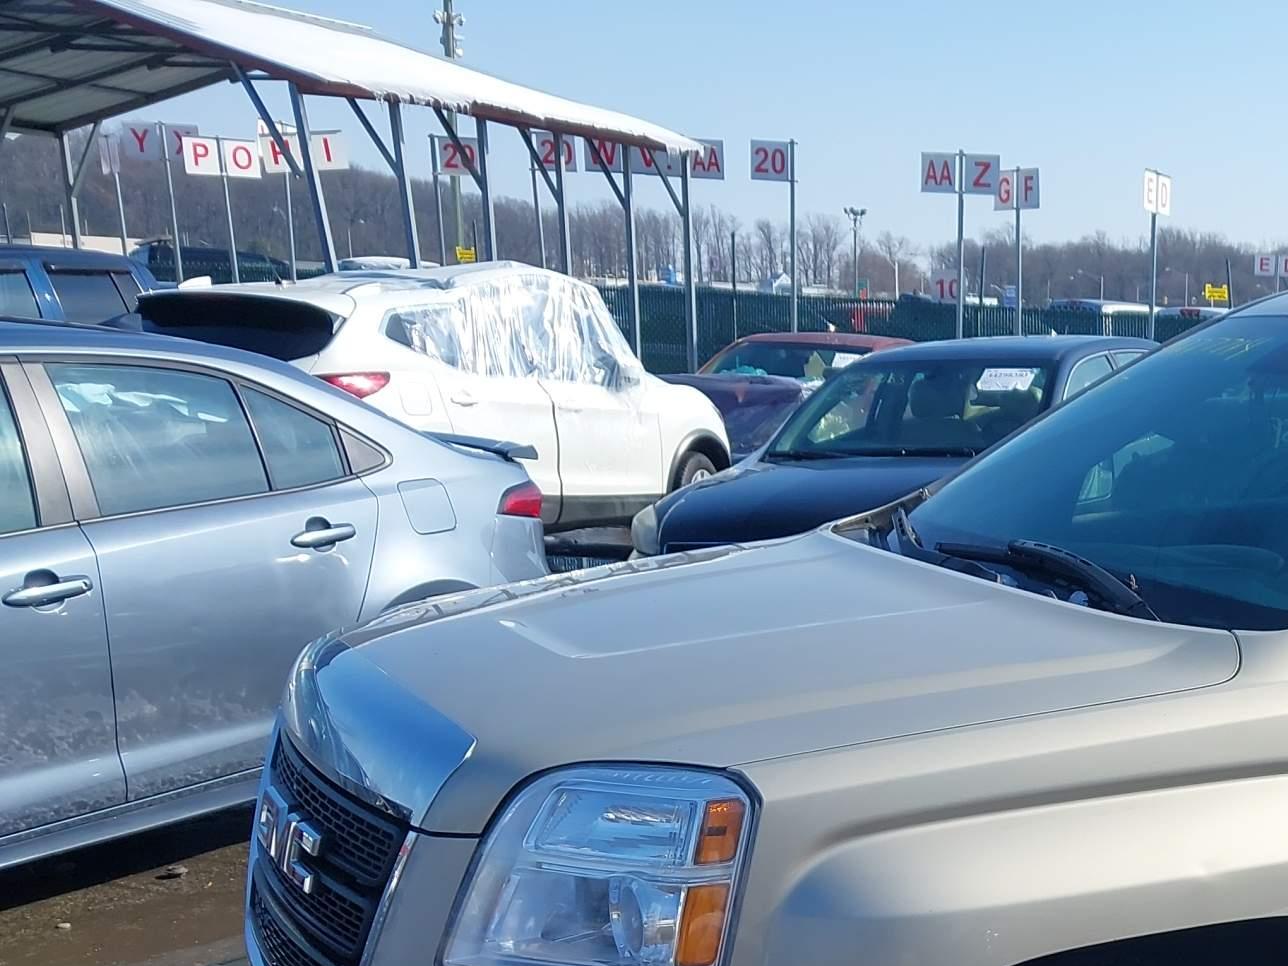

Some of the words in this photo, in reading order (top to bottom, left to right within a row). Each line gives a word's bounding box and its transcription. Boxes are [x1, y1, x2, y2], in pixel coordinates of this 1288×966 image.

[130, 127, 149, 153] Y
[191, 141, 209, 166] P
[443, 143, 475, 168] 20
[693, 146, 721, 172] AA
[754, 147, 785, 175] 20
[924, 159, 953, 186] AA
[973, 161, 992, 188] Z
[998, 177, 1011, 204] G
[1024, 175, 1034, 203] F
[1260, 257, 1270, 272] E
[256, 785, 322, 895] MC
